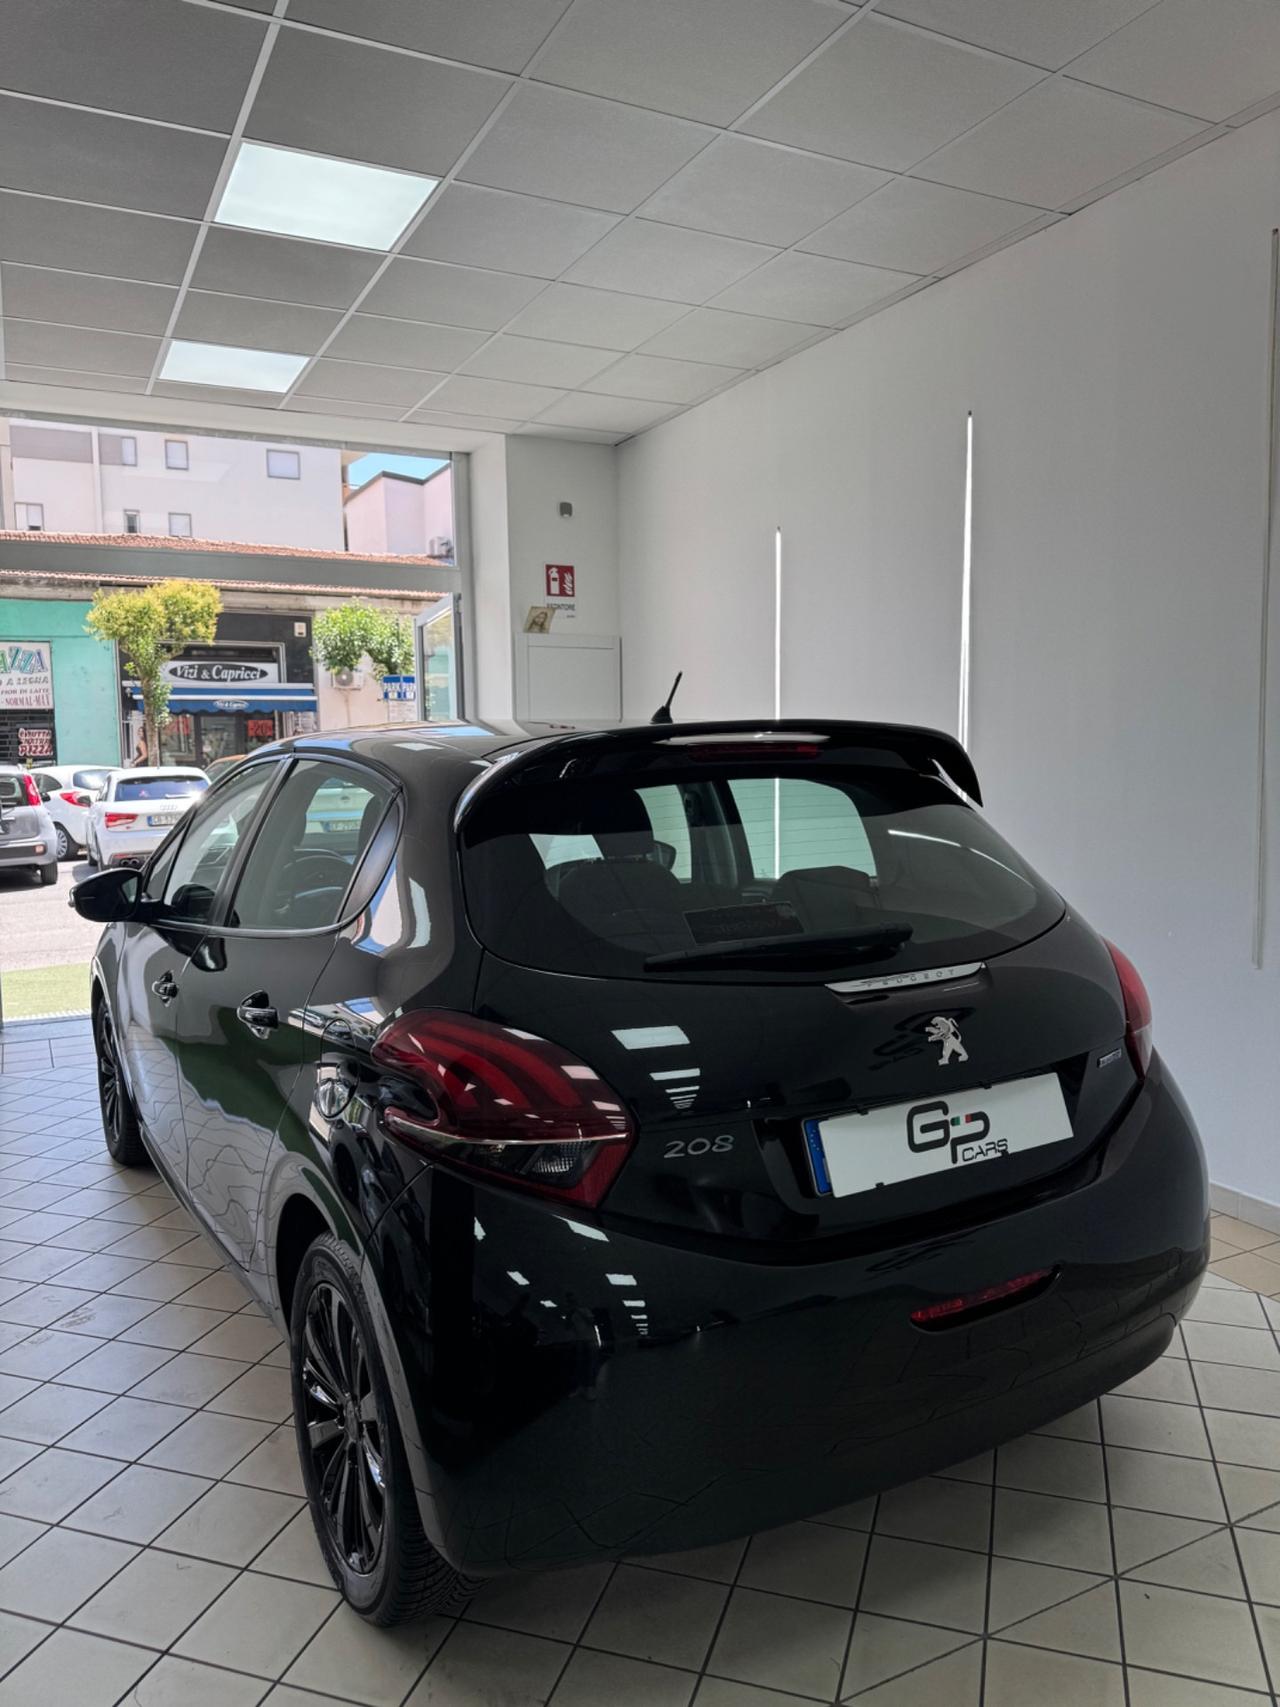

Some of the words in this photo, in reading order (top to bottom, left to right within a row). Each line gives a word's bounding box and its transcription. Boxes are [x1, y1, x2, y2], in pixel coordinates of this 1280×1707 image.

[176, 665, 198, 679] Vizi
[201, 669, 210, 679] &
[212, 664, 261, 682] Capricci
[19, 745, 53, 756] PIZZA
[866, 968, 954, 988] PEUGEOT
[664, 1134, 734, 1158] 208
[962, 1138, 1008, 1161] CARS
